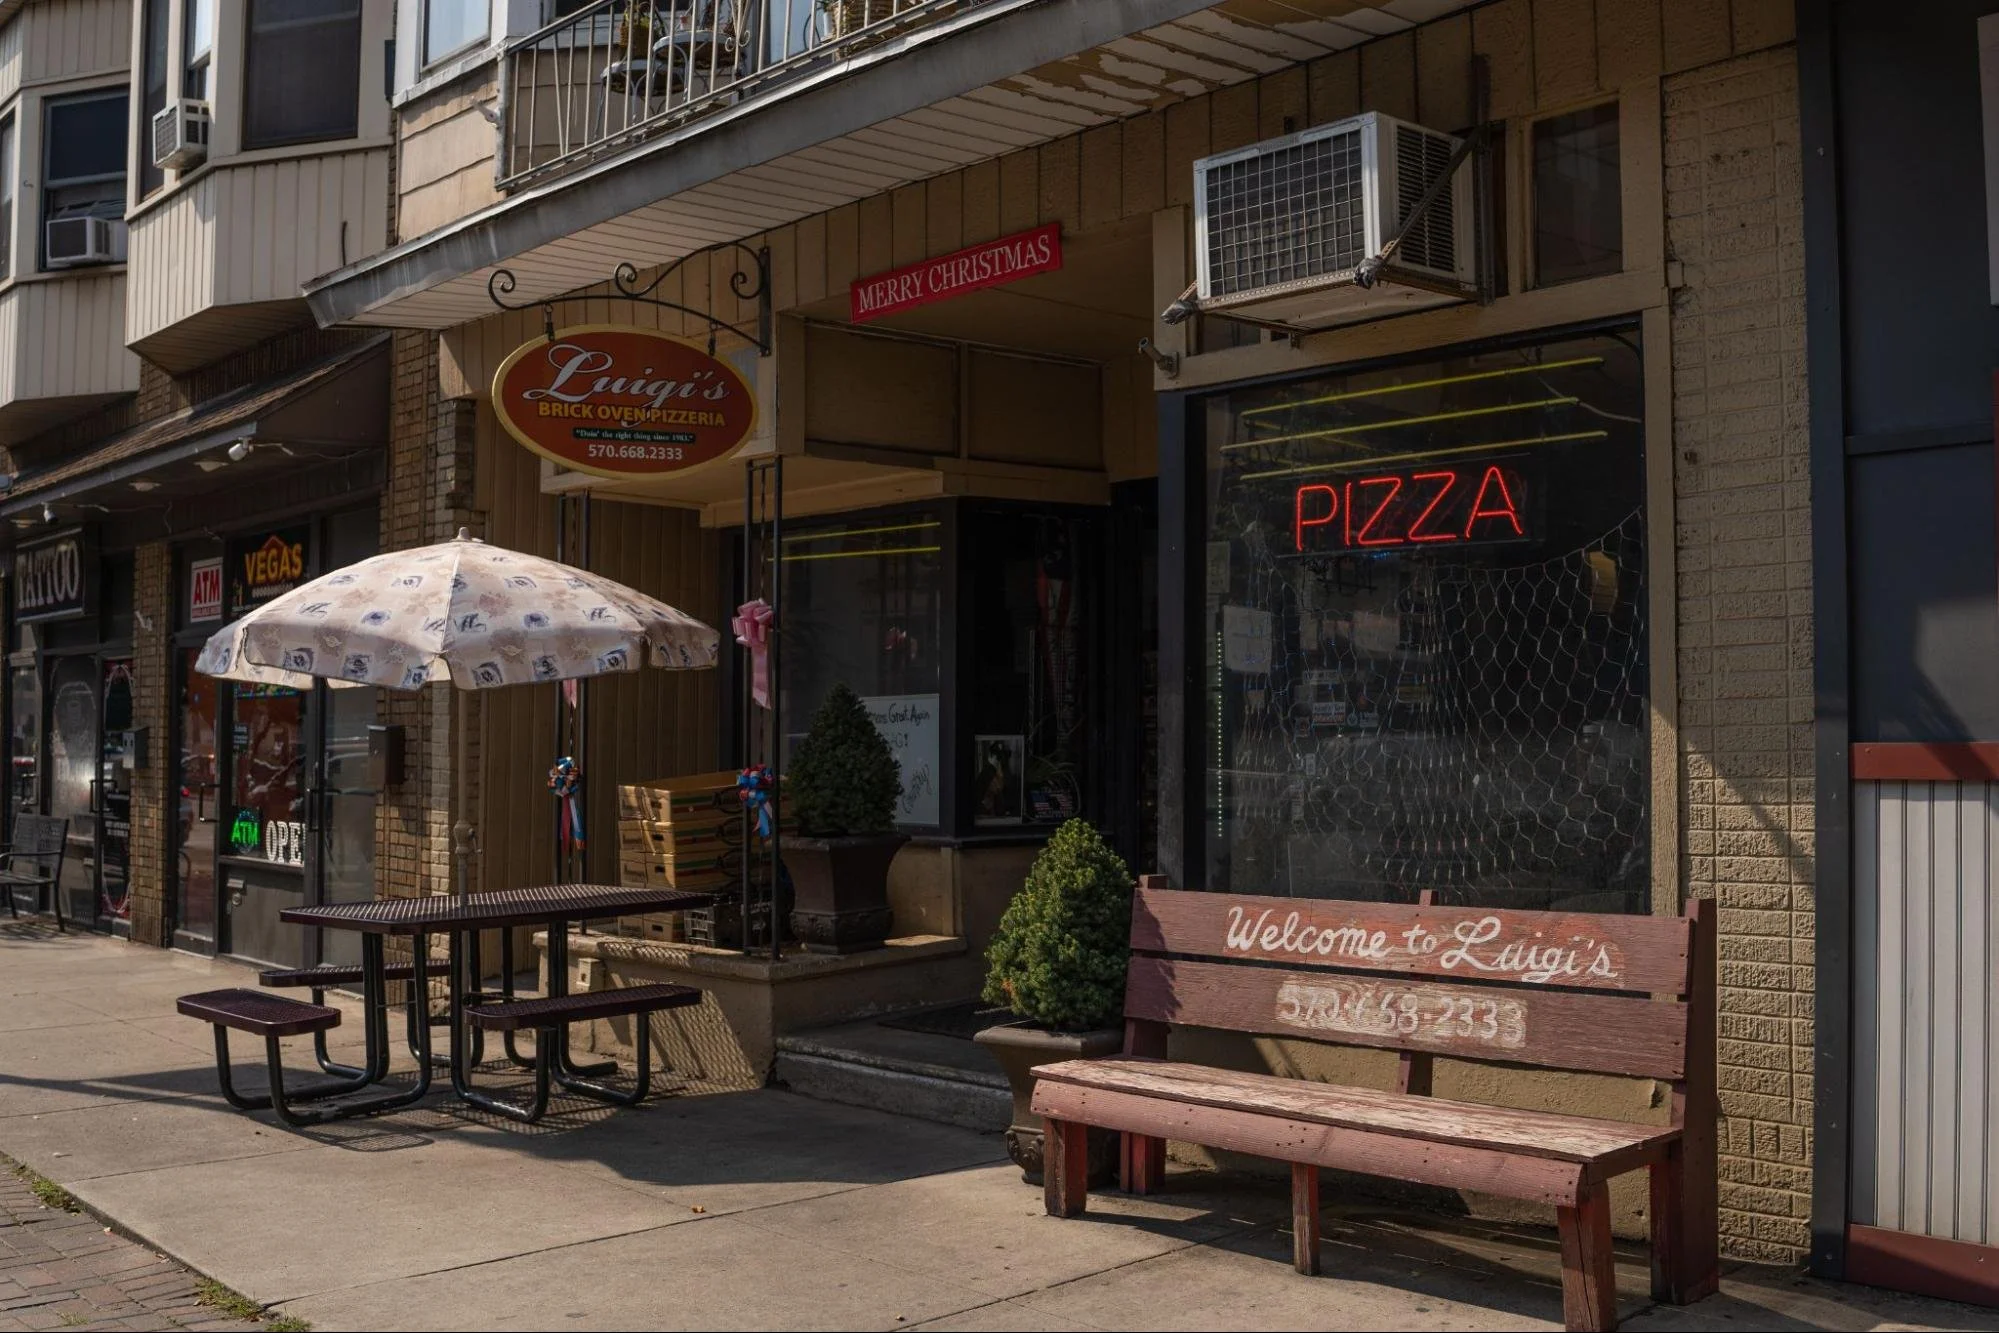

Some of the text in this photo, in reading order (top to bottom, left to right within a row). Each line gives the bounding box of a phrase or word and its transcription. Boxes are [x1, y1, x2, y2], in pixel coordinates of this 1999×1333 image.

[858, 234, 1051, 313] MERRY CHRISTMAS
[522, 344, 729, 428] Luigi's
[538, 402, 726, 427] BRICK OVEN PIZZERIA
[615, 432, 632, 440] right
[634, 433, 652, 441] thing
[588, 444, 683, 460] 570.668.2333
[1295, 464, 1524, 552] PIZZA
[16, 540, 80, 609] TATTOO
[243, 543, 303, 585] VEGAS
[194, 568, 220, 605] ATM
[230, 818, 260, 846] ATM
[265, 820, 306, 867] OPE
[1227, 906, 1618, 983] Welcome to Luigi's
